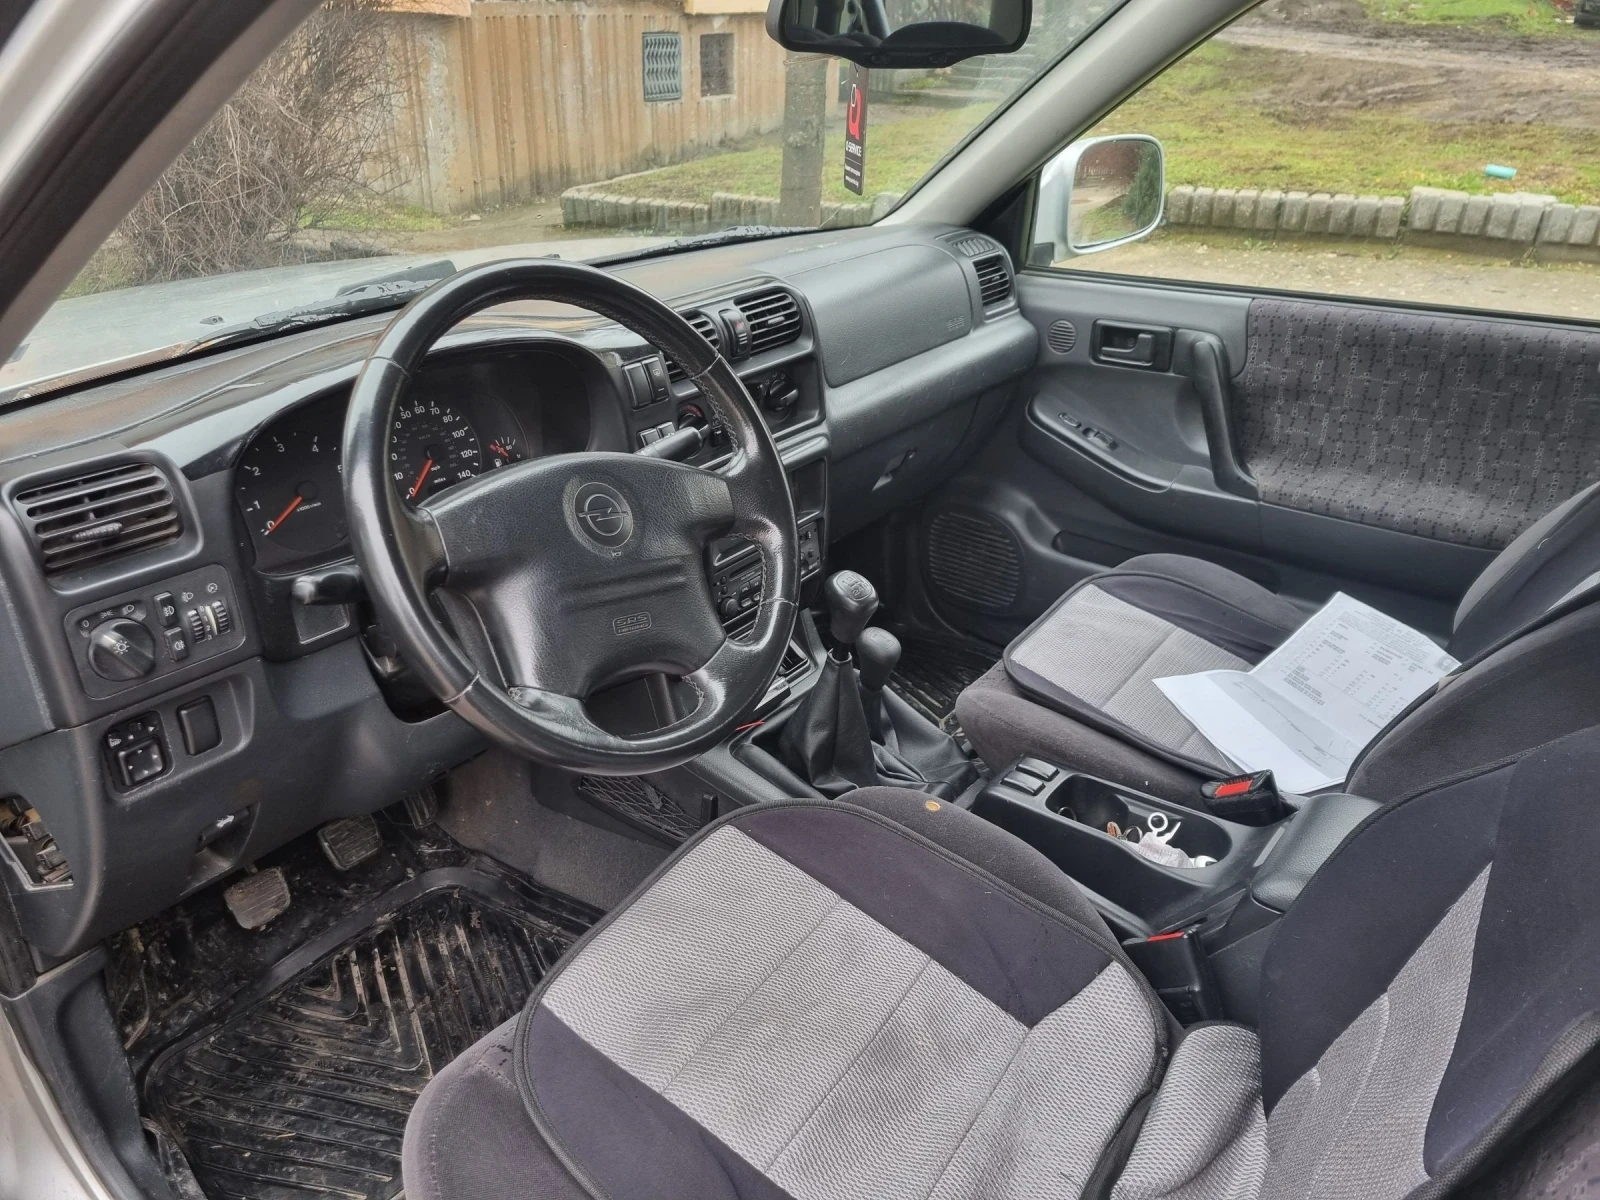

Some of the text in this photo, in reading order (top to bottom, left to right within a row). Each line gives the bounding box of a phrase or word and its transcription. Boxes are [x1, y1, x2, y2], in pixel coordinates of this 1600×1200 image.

[414, 405, 425, 414] 60
[430, 407, 440, 415] 70
[400, 410, 411, 419] 50
[443, 414, 453, 423] 80
[452, 429, 465, 439] 100
[277, 443, 285, 453] 3
[312, 444, 319, 452] 4
[460, 449, 473, 458] 120
[252, 466, 261, 476] 2
[458, 469, 471, 479] 140
[394, 471, 403, 481] 10
[254, 500, 260, 509] 1
